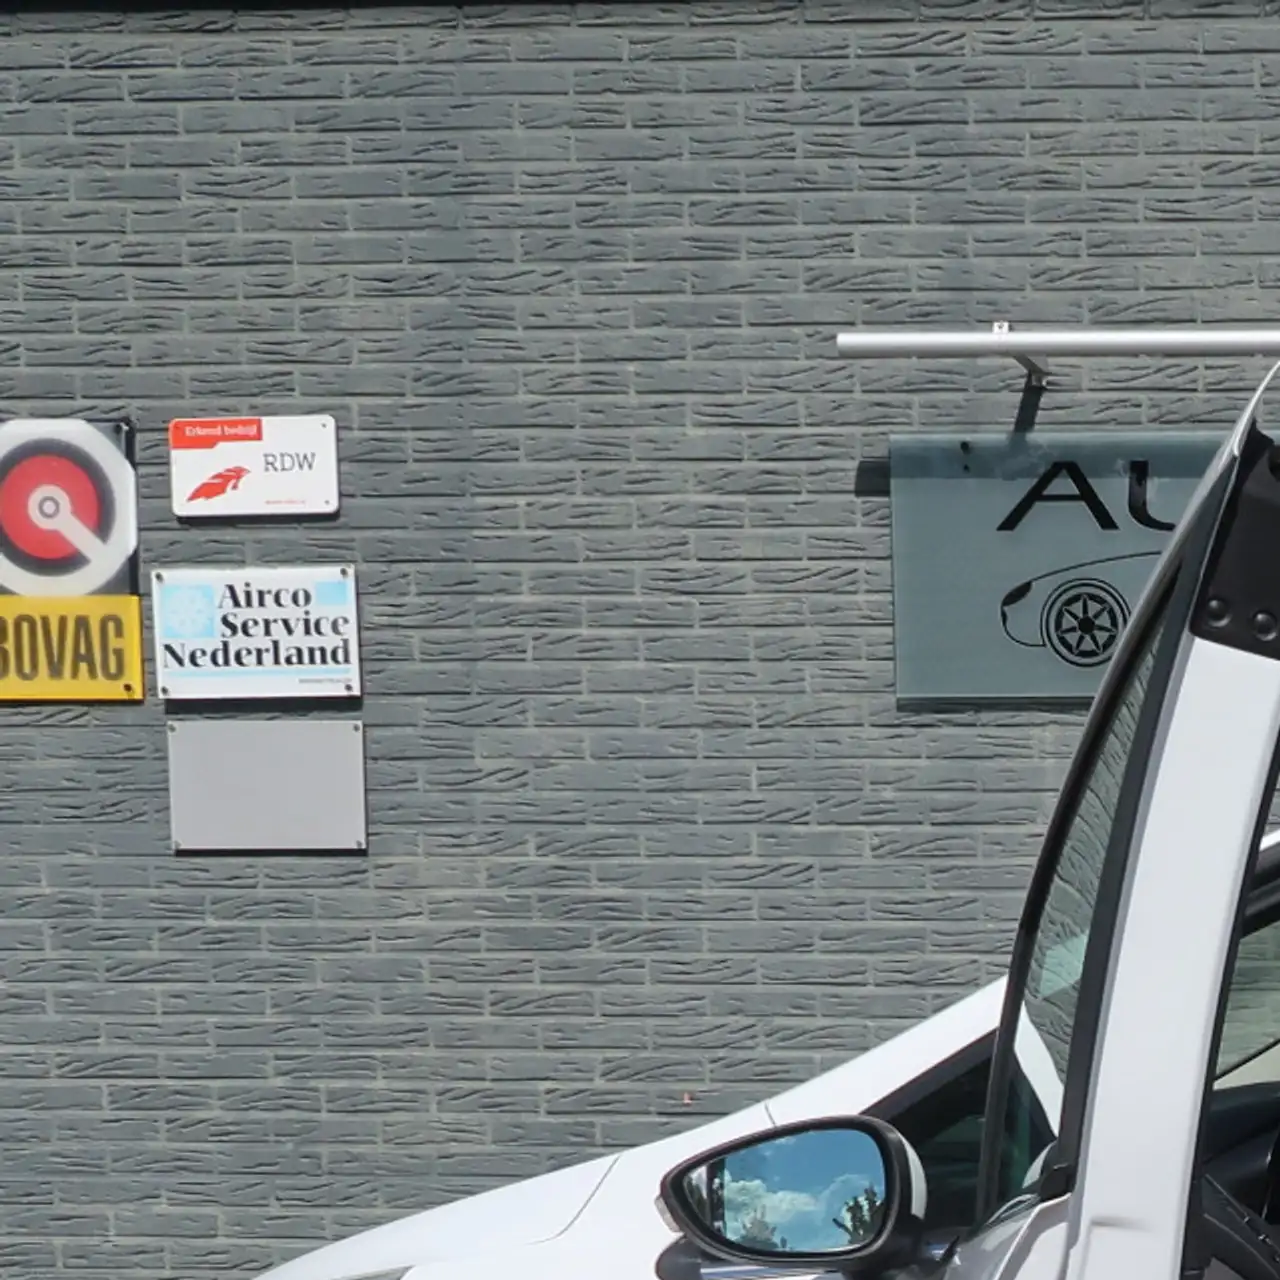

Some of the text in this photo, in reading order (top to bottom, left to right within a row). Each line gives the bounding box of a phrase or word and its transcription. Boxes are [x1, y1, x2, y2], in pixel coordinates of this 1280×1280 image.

[263, 452, 316, 472] RDW
[218, 582, 312, 609] Airco
[220, 610, 350, 638] Service
[162, 638, 352, 668] Nederland
